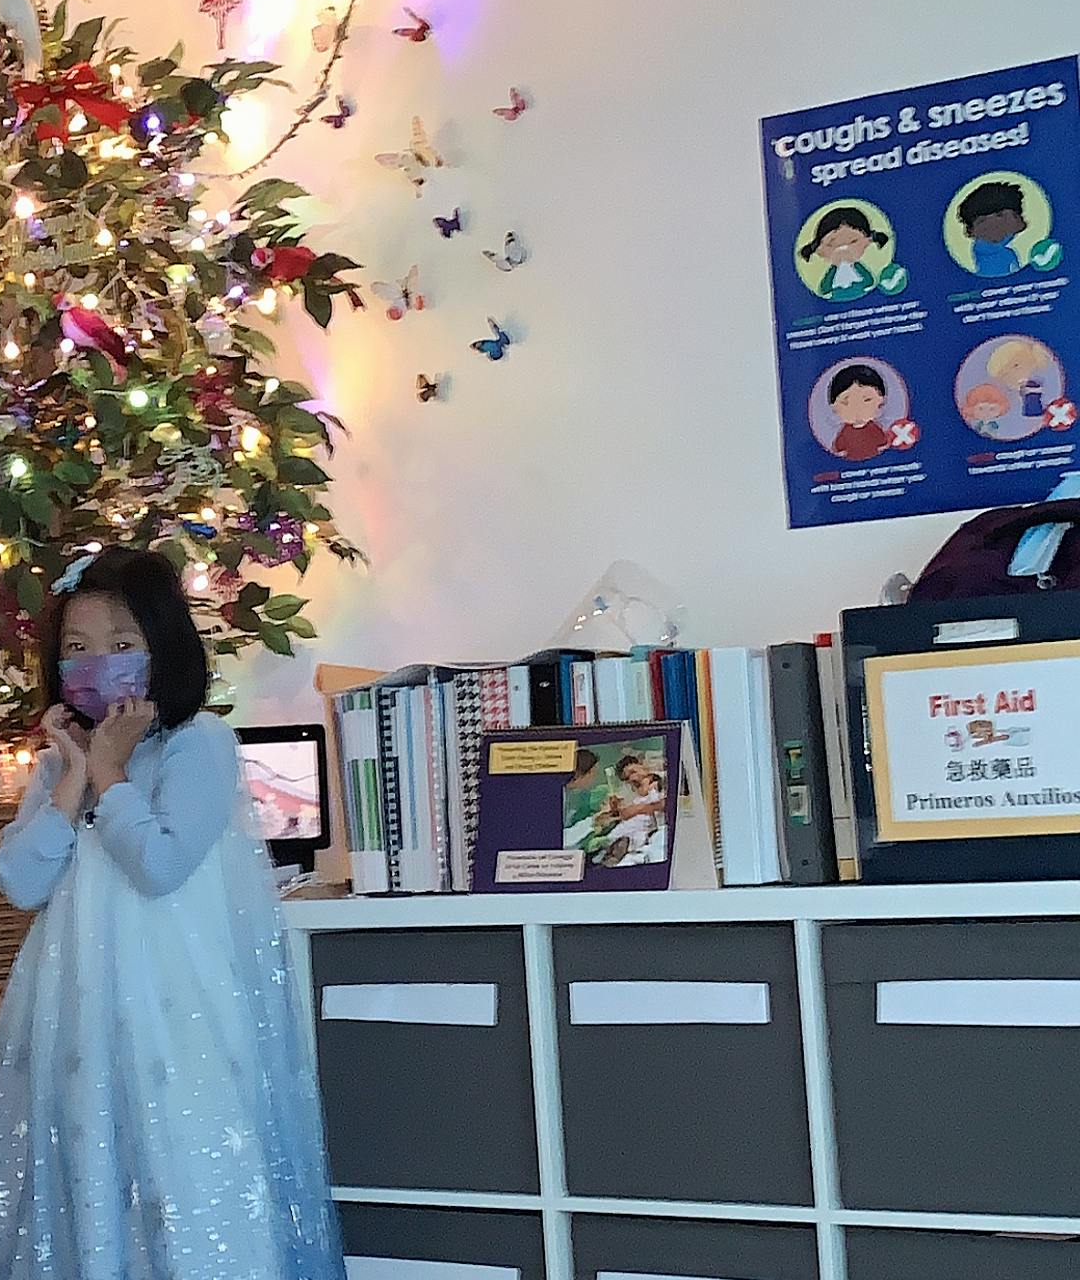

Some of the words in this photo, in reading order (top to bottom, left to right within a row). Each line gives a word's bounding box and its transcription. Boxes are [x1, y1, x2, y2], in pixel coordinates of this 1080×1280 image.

[898, 106, 921, 133] &
[928, 81, 1066, 128] sneezes
[811, 144, 903, 186] spread
[906, 122, 1031, 166] diseases!
[928, 693, 986, 718] First
[995, 689, 1035, 713] Aid
[946, 757, 1037, 782] 急救藥品
[907, 792, 993, 810] Primeros
[1001, 787, 1080, 809] Auxilios
